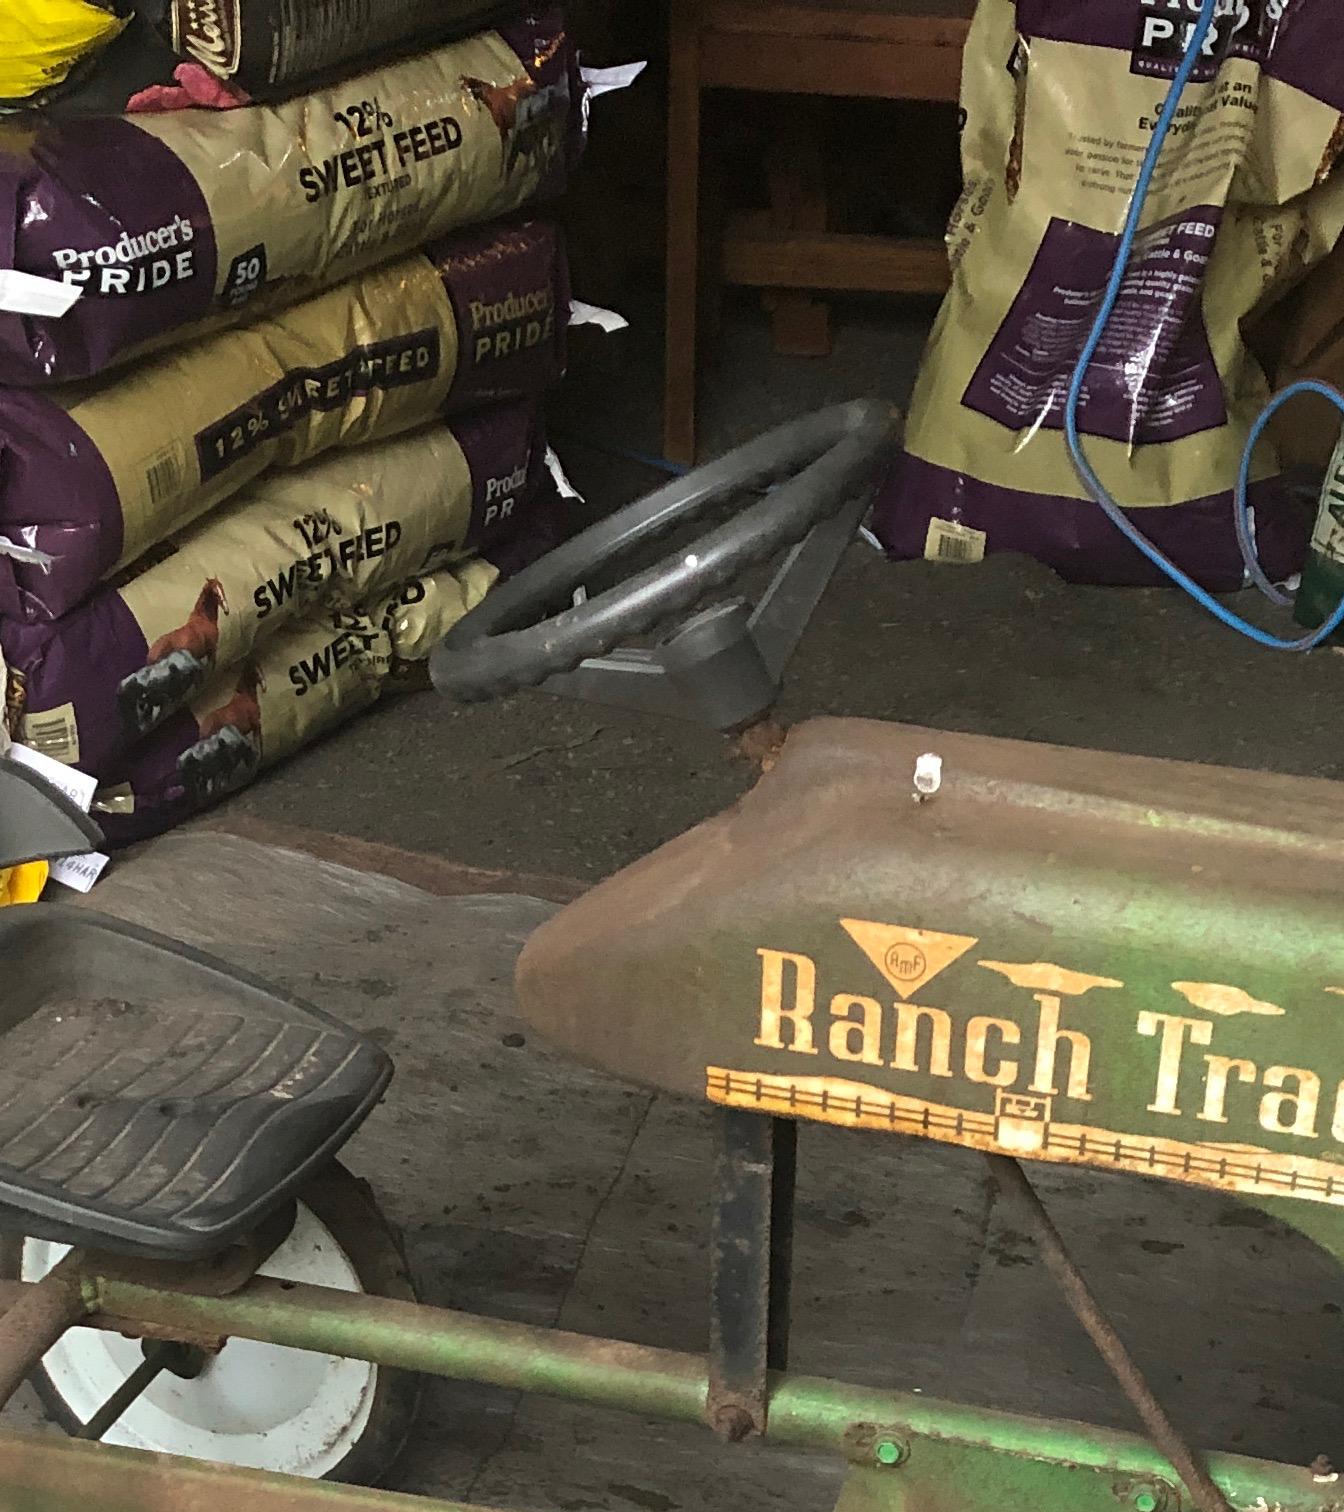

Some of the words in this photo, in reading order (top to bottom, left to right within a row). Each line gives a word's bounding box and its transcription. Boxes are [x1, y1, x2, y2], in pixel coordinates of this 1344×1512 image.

[299, 139, 388, 203] SWEET
[394, 116, 463, 167] FEED
[53, 214, 193, 270] Producer's
[1177, 222, 1216, 238] FEED
[63, 250, 194, 294] PRIDE
[235, 257, 260, 285] 50
[216, 410, 269, 459] 12%
[754, 948, 1093, 1101] Ranch
